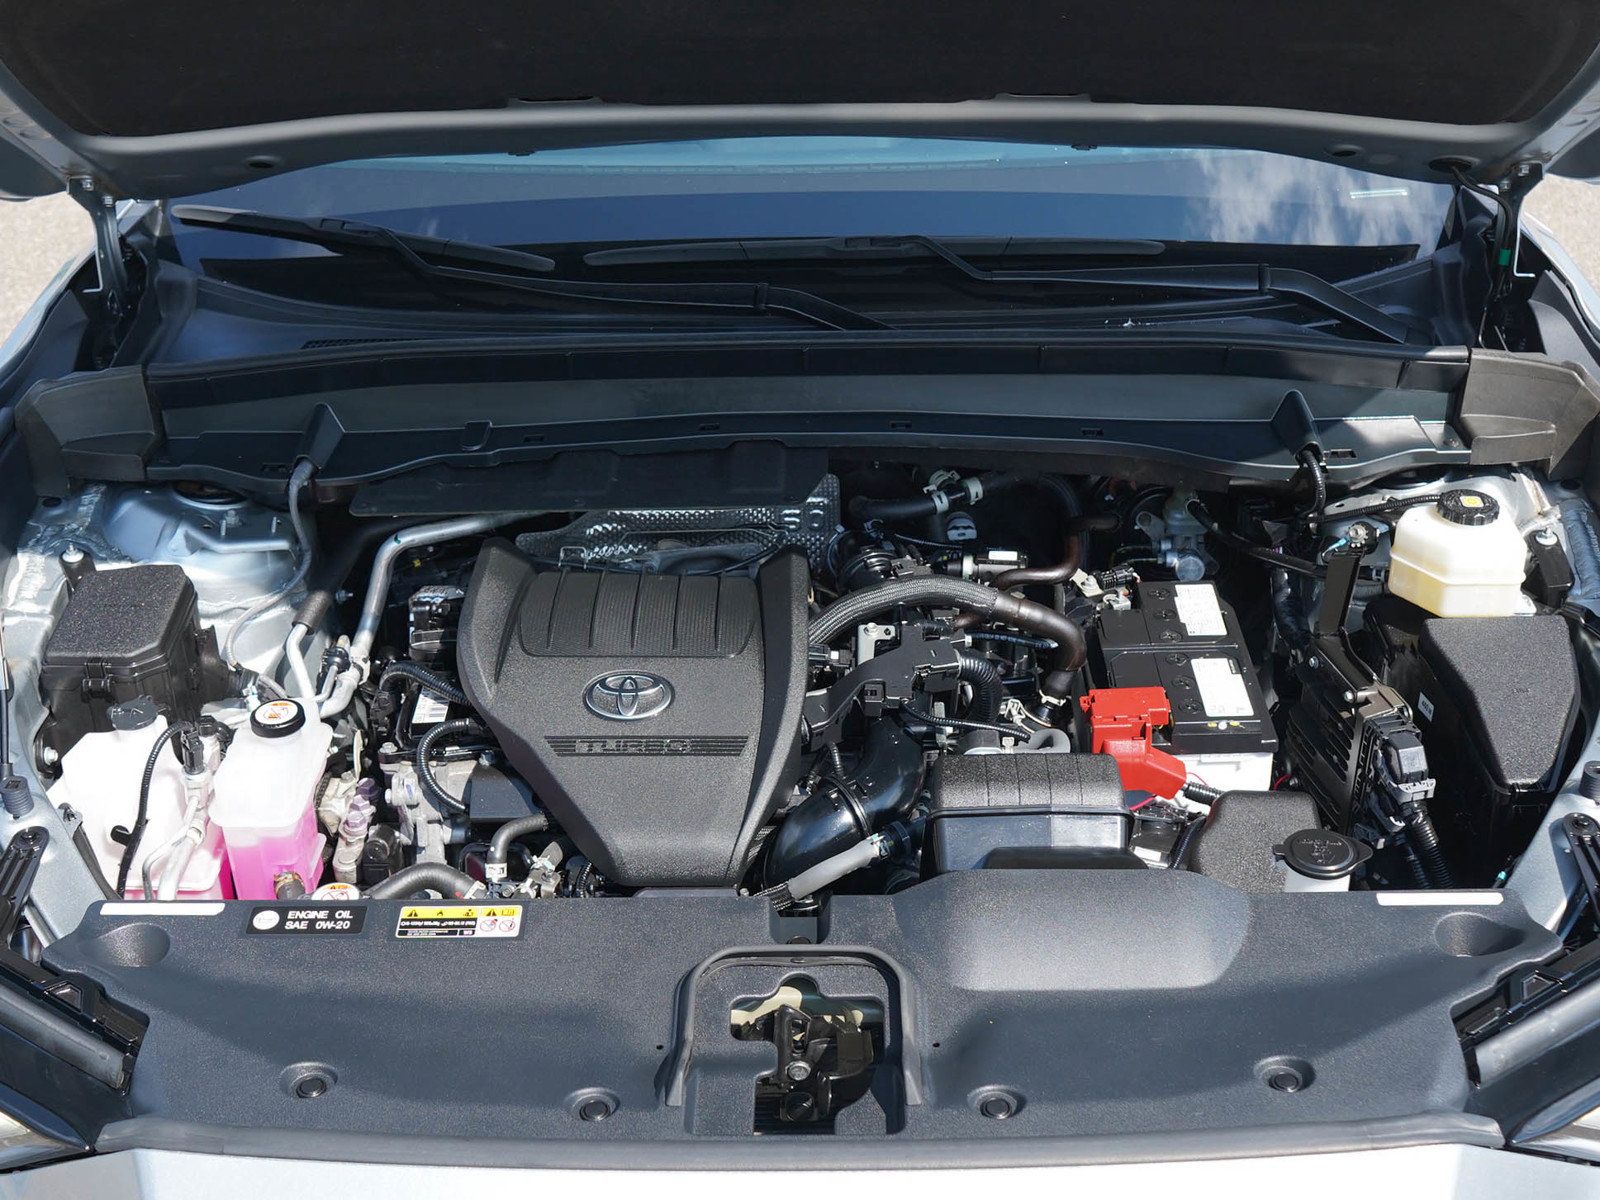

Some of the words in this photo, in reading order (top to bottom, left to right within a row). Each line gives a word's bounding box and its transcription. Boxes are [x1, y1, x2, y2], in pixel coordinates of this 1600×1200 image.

[287, 910, 329, 919] ENGINE
[335, 910, 353, 919] OIL
[284, 921, 309, 930] SAE
[315, 920, 350, 930] 0W-20
